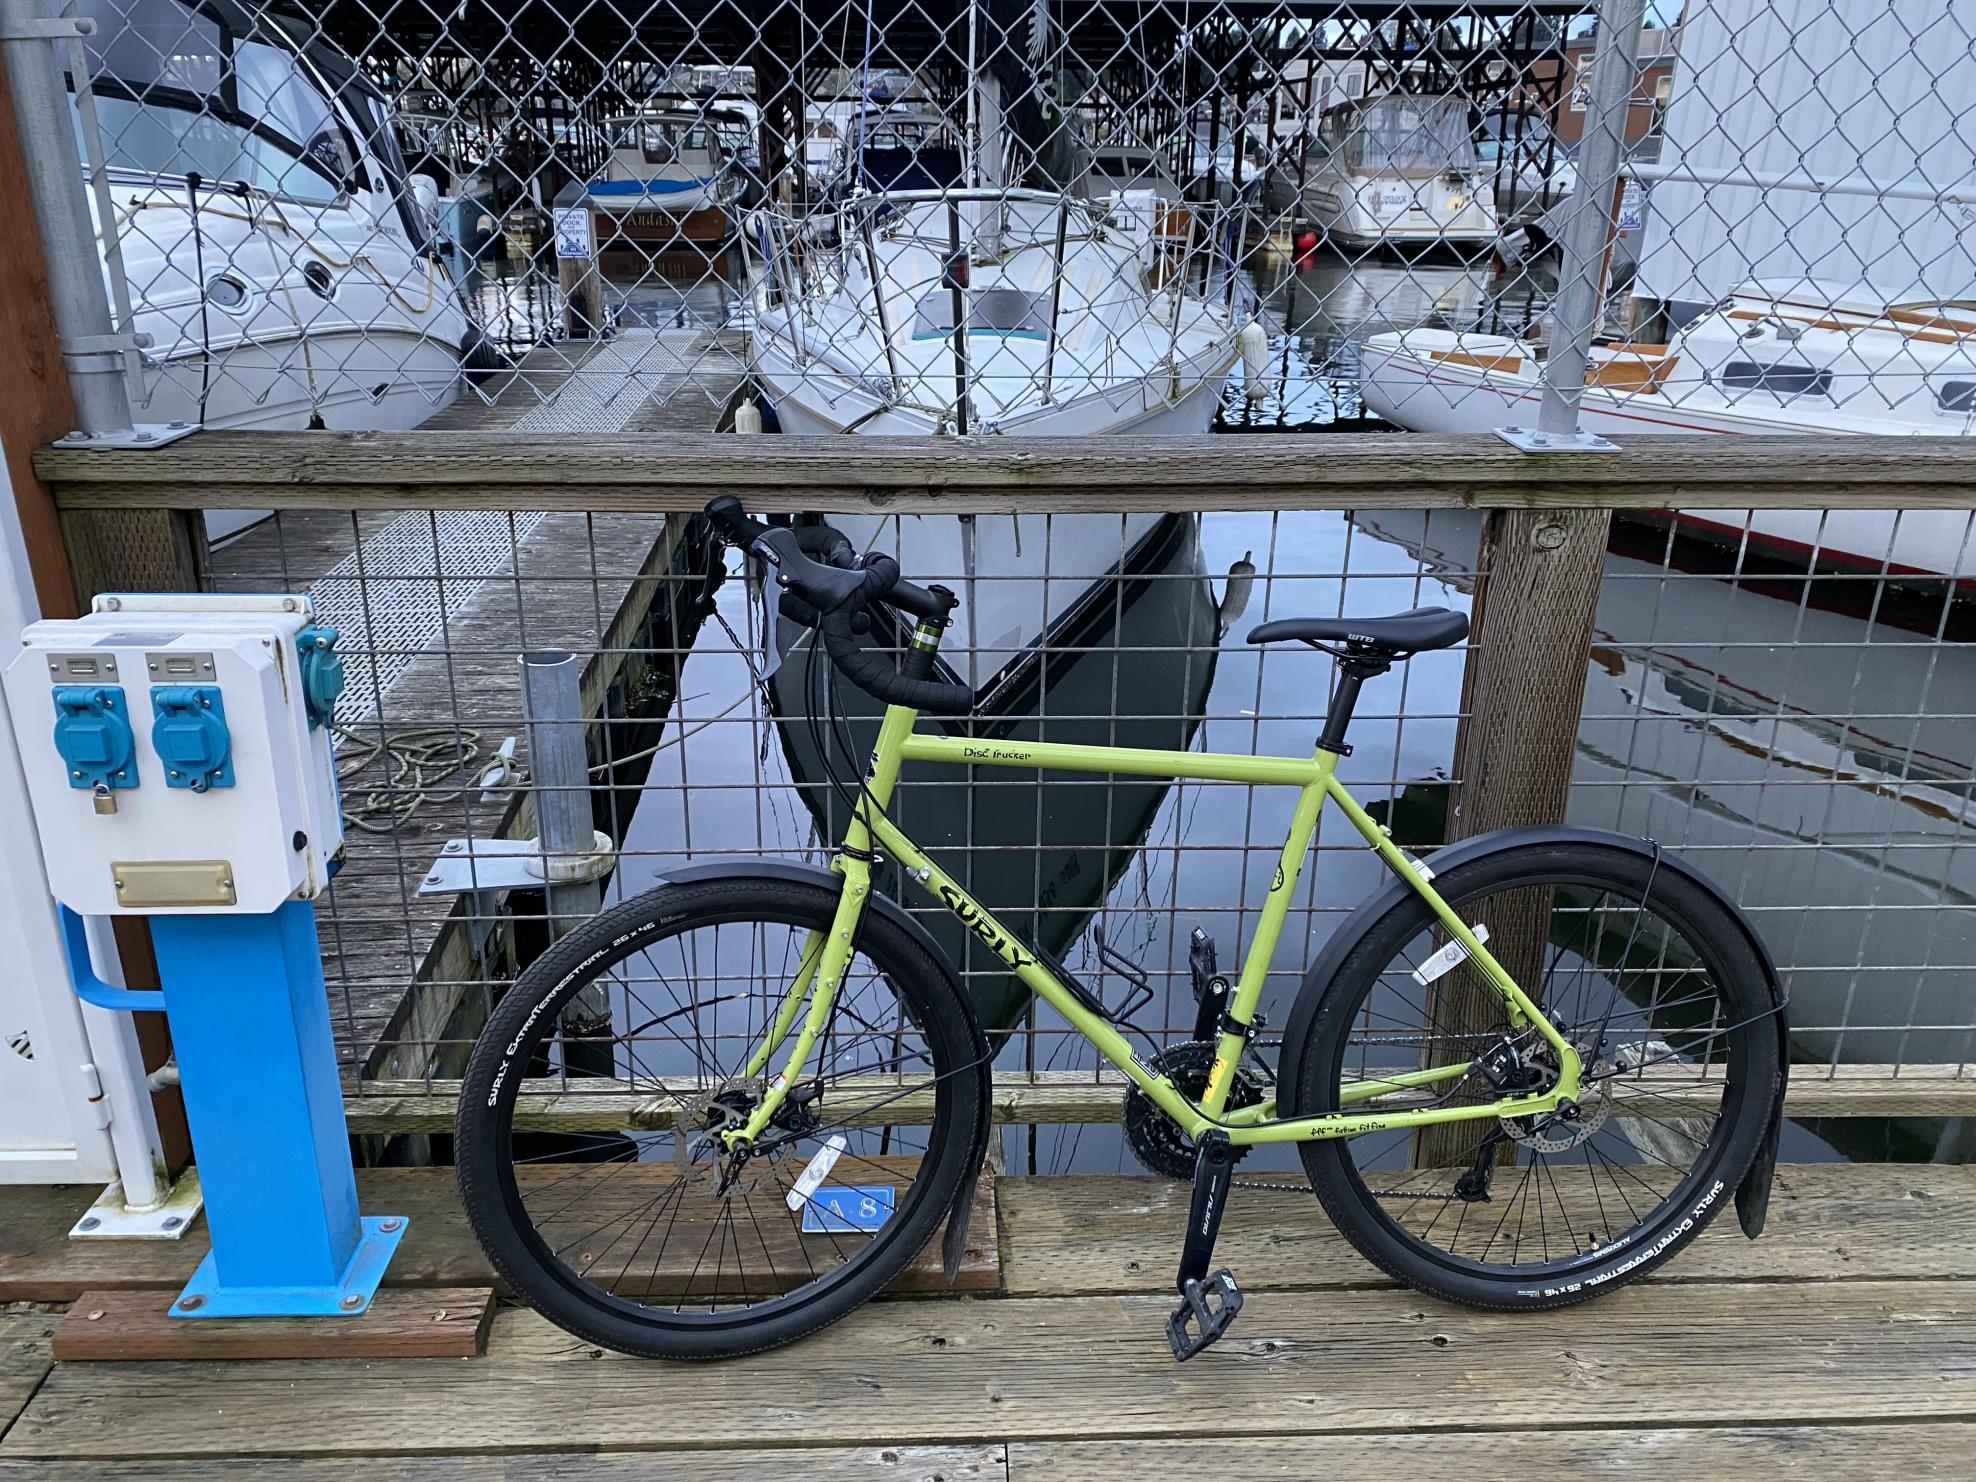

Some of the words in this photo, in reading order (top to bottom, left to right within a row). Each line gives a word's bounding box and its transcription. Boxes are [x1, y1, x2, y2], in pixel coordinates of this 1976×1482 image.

[1348, 634, 1375, 643] WTB
[964, 746, 990, 758] Disc
[993, 748, 1032, 760] Trucker
[940, 885, 1032, 970] SURLY
[488, 1060, 510, 1106] SURLY
[612, 934, 629, 947] 26
[638, 922, 655, 933] 46
[823, 1198, 845, 1219] A
[858, 1197, 877, 1218] 8
[1692, 1180, 1724, 1218] SURLY
[1544, 1288, 1558, 1297] 46
[1566, 1283, 1582, 1292] 26
